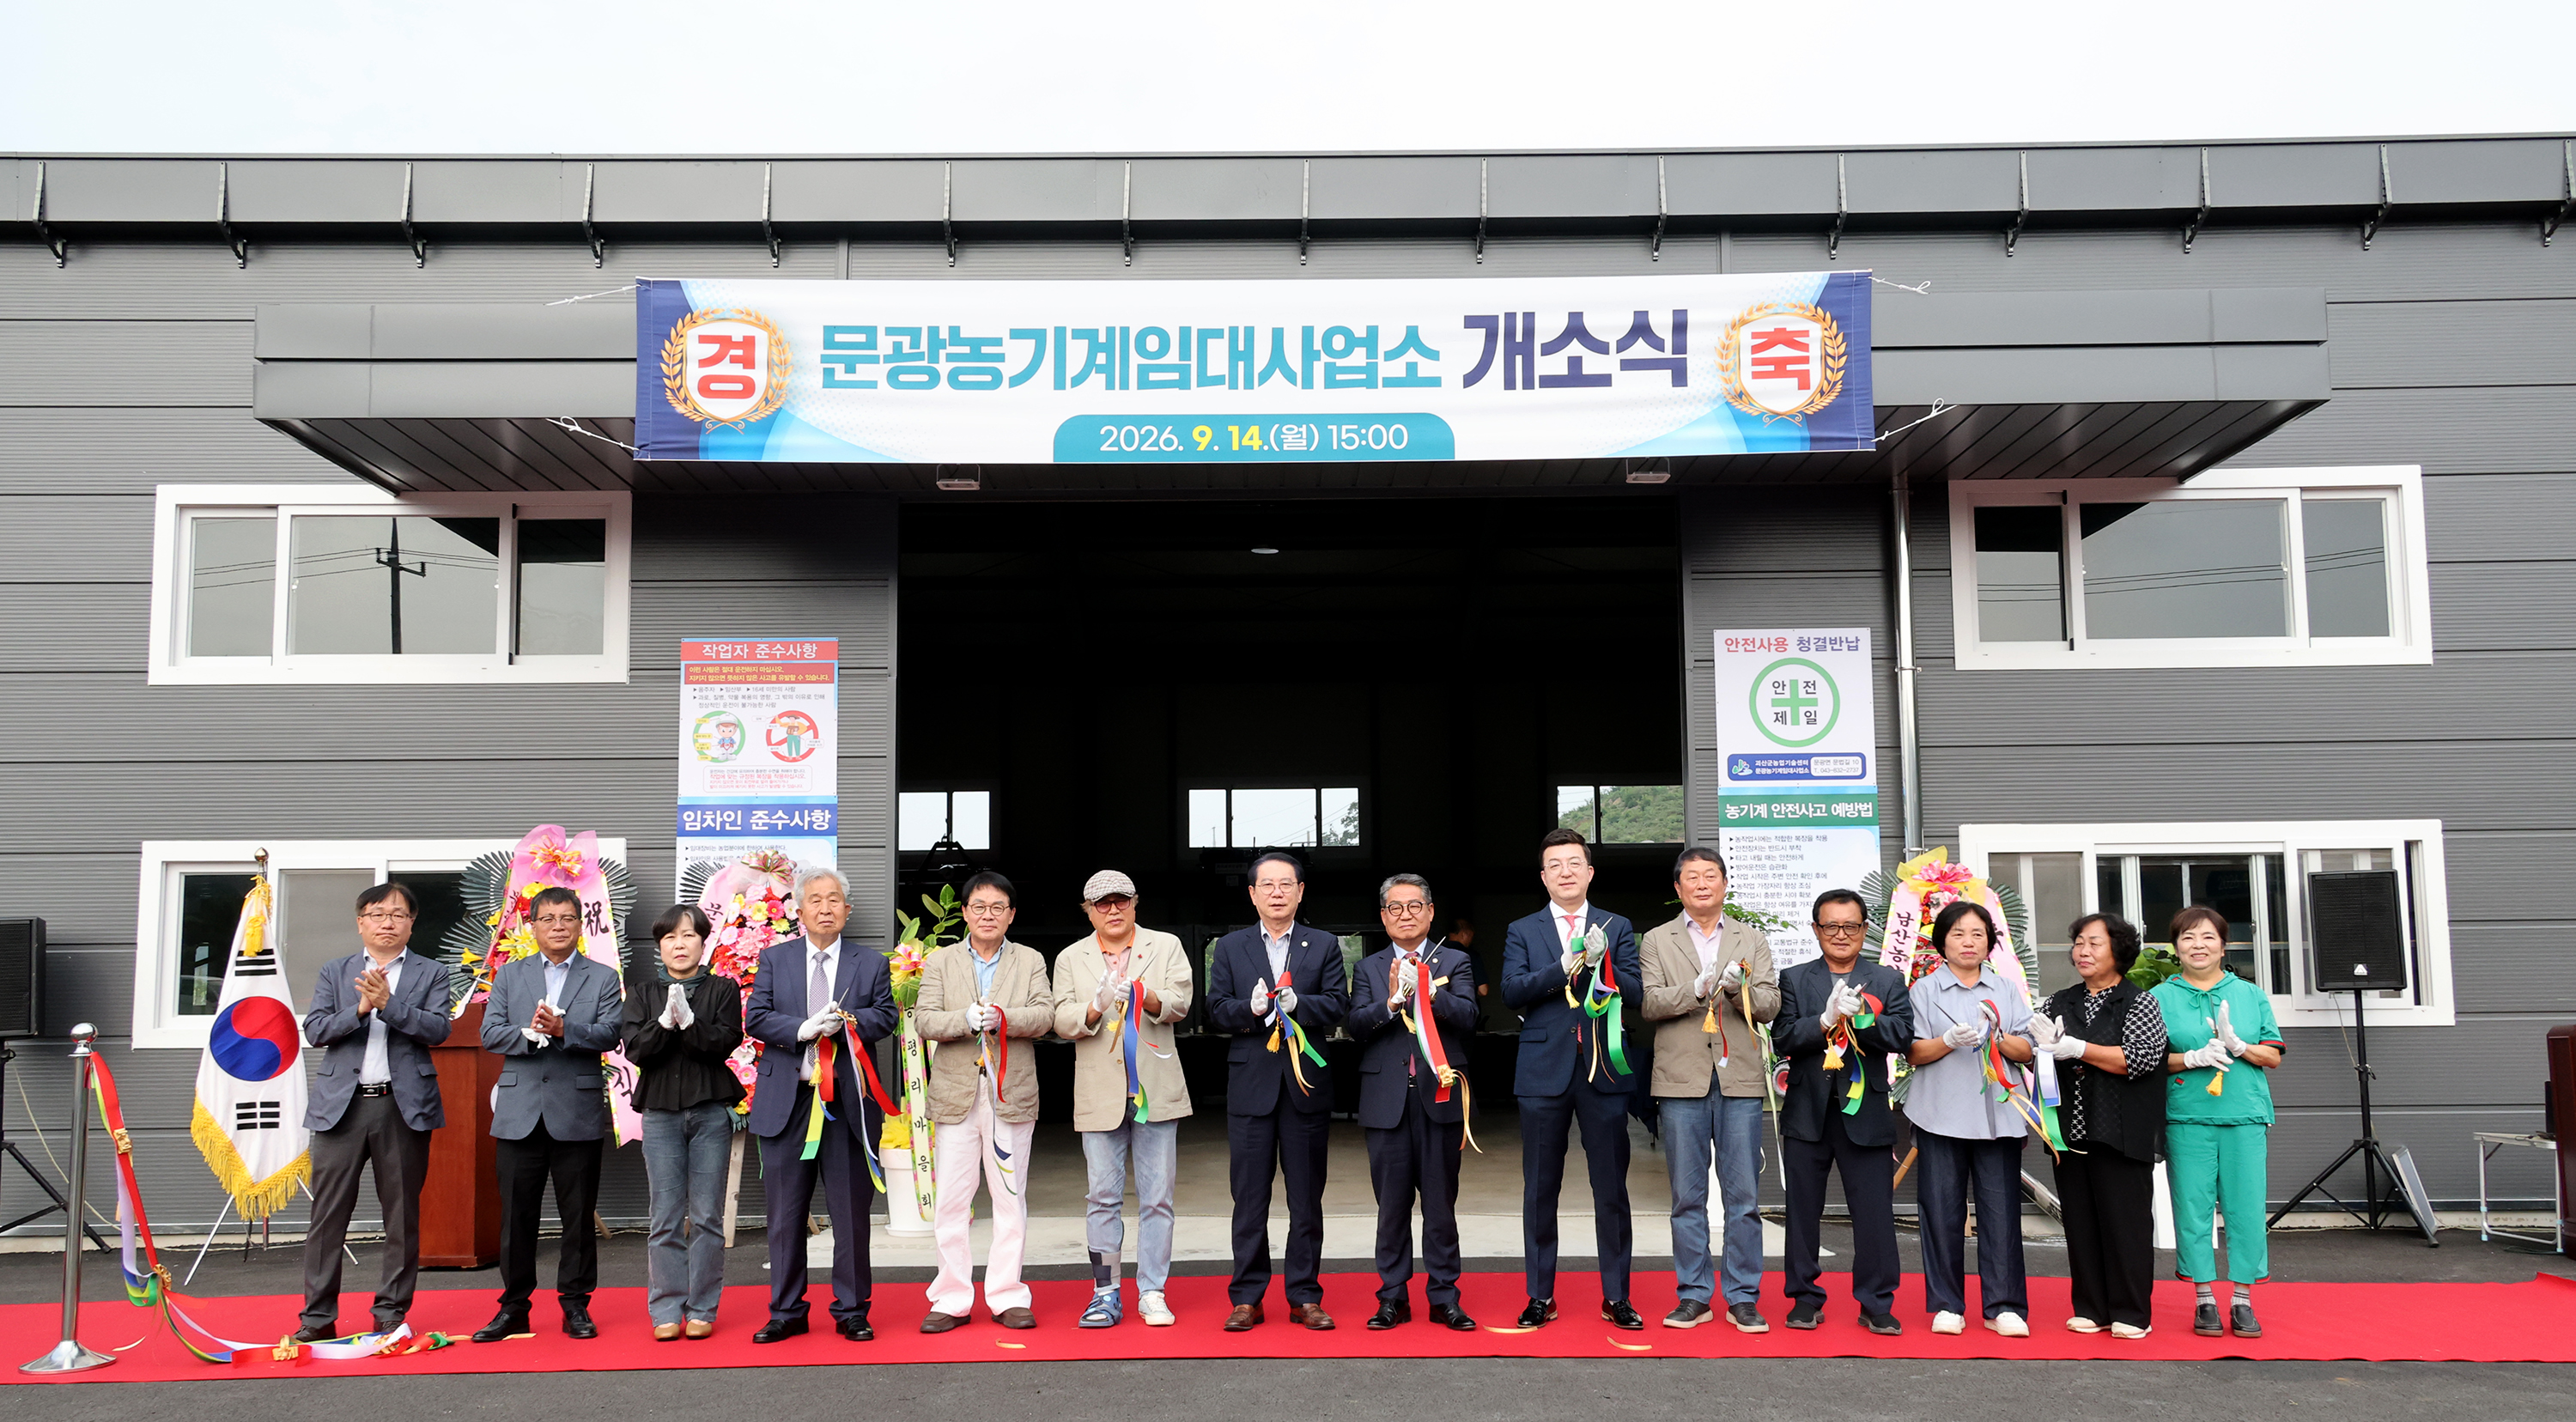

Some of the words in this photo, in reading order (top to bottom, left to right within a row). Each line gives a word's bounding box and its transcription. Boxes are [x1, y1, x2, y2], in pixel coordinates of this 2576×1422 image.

[820, 325, 1442, 392] 문광농기계임대사업소
[1462, 309, 1688, 391] 개소식
[1750, 327, 1811, 392] 축
[696, 333, 756, 400] 경
[1100, 424, 1184, 452] 2026.
[1192, 425, 1219, 452] 9.
[1327, 423, 1408, 450] 15:00
[702, 643, 749, 659] 작업자
[755, 642, 817, 659] 준수사항
[1724, 637, 1789, 653] 안전사용
[1796, 636, 1860, 652] 청결반납
[1772, 680, 1786, 695] 안
[1802, 680, 1817, 695] 전
[1774, 711, 1787, 725] 제
[1804, 710, 1818, 725] 일
[682, 810, 742, 831] 임차인
[749, 809, 831, 830] 준수사항
[1725, 803, 1767, 818] 농기계
[1771, 803, 1828, 818] 안전사고
[1832, 802, 1873, 817] 예방법
[584, 900, 608, 938] 祝
